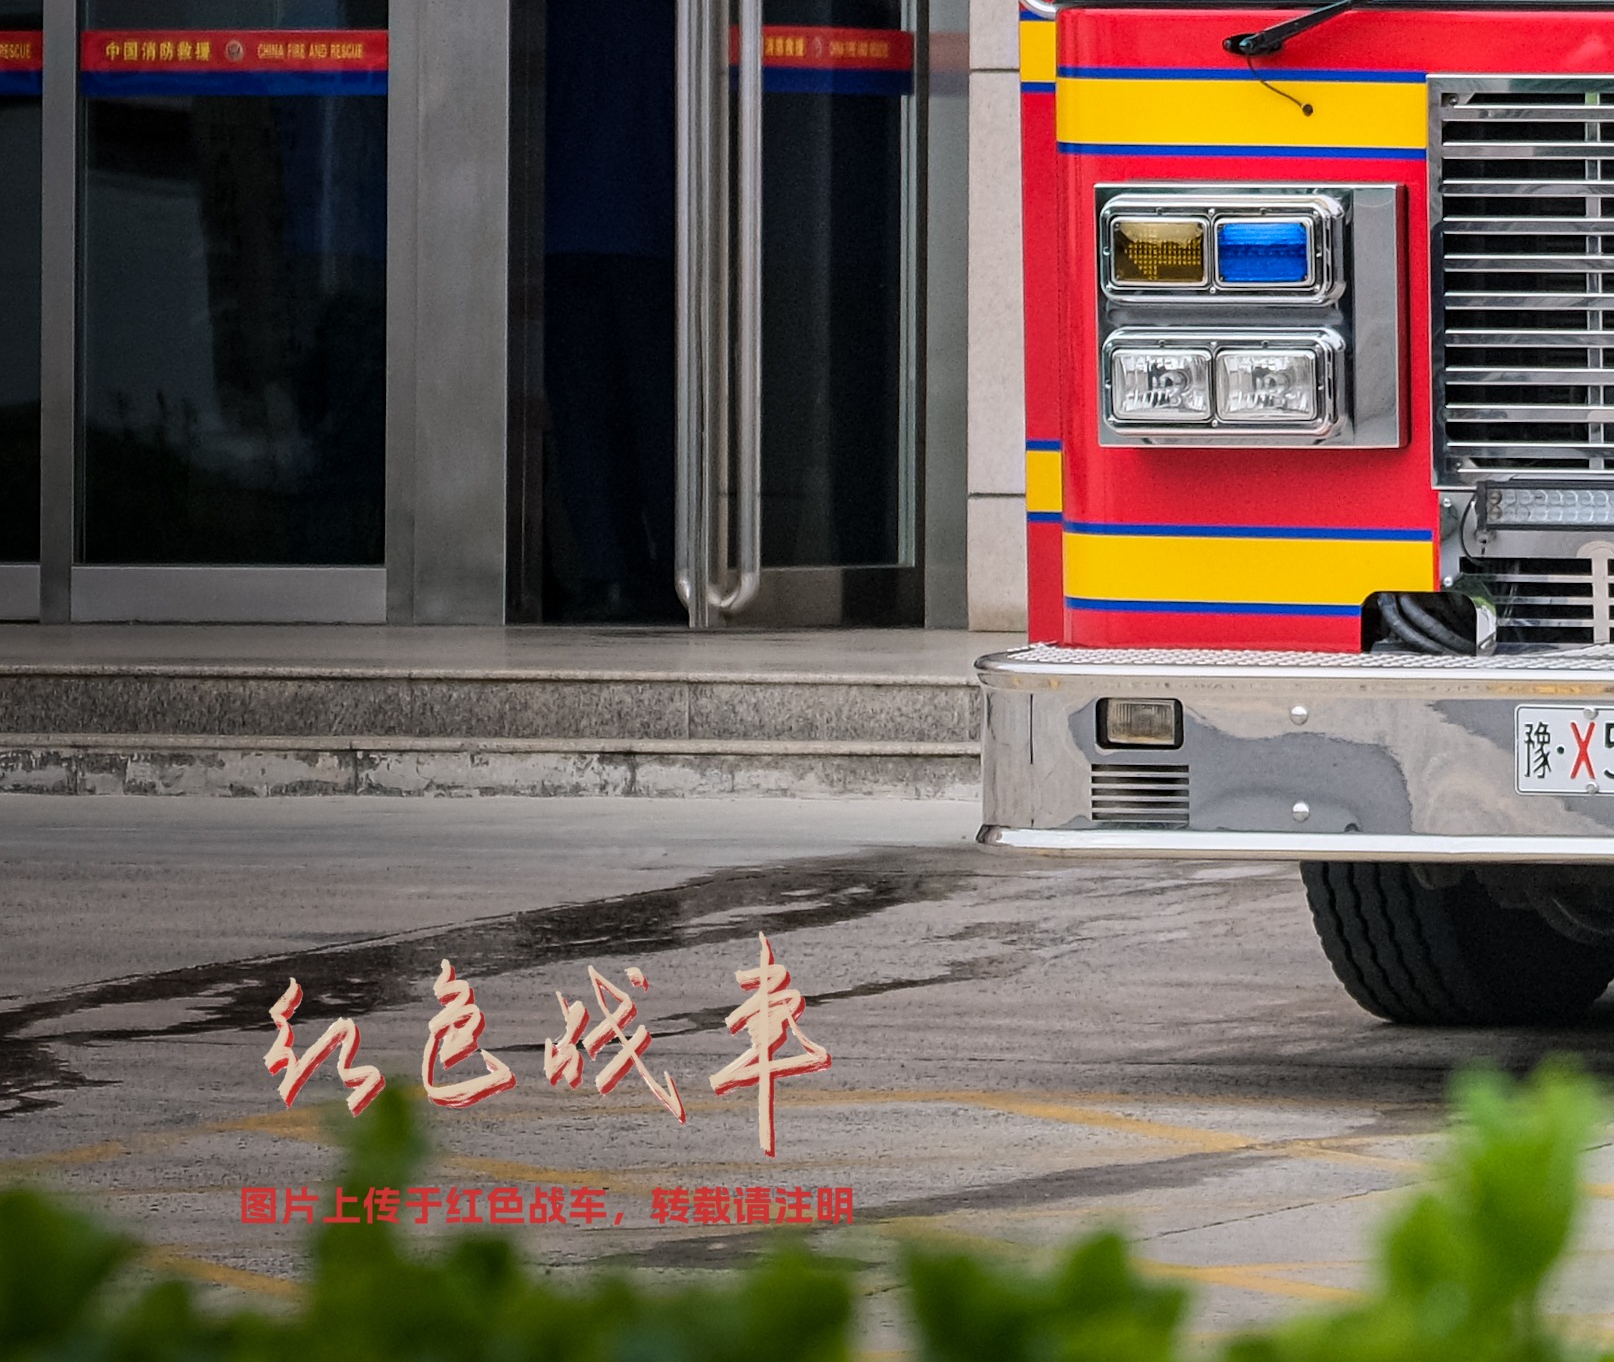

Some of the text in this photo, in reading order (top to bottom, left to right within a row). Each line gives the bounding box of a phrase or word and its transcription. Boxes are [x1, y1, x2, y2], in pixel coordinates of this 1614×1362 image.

[105, 40, 210, 61] 中国消防救援
[257, 43, 284, 59] CHINA
